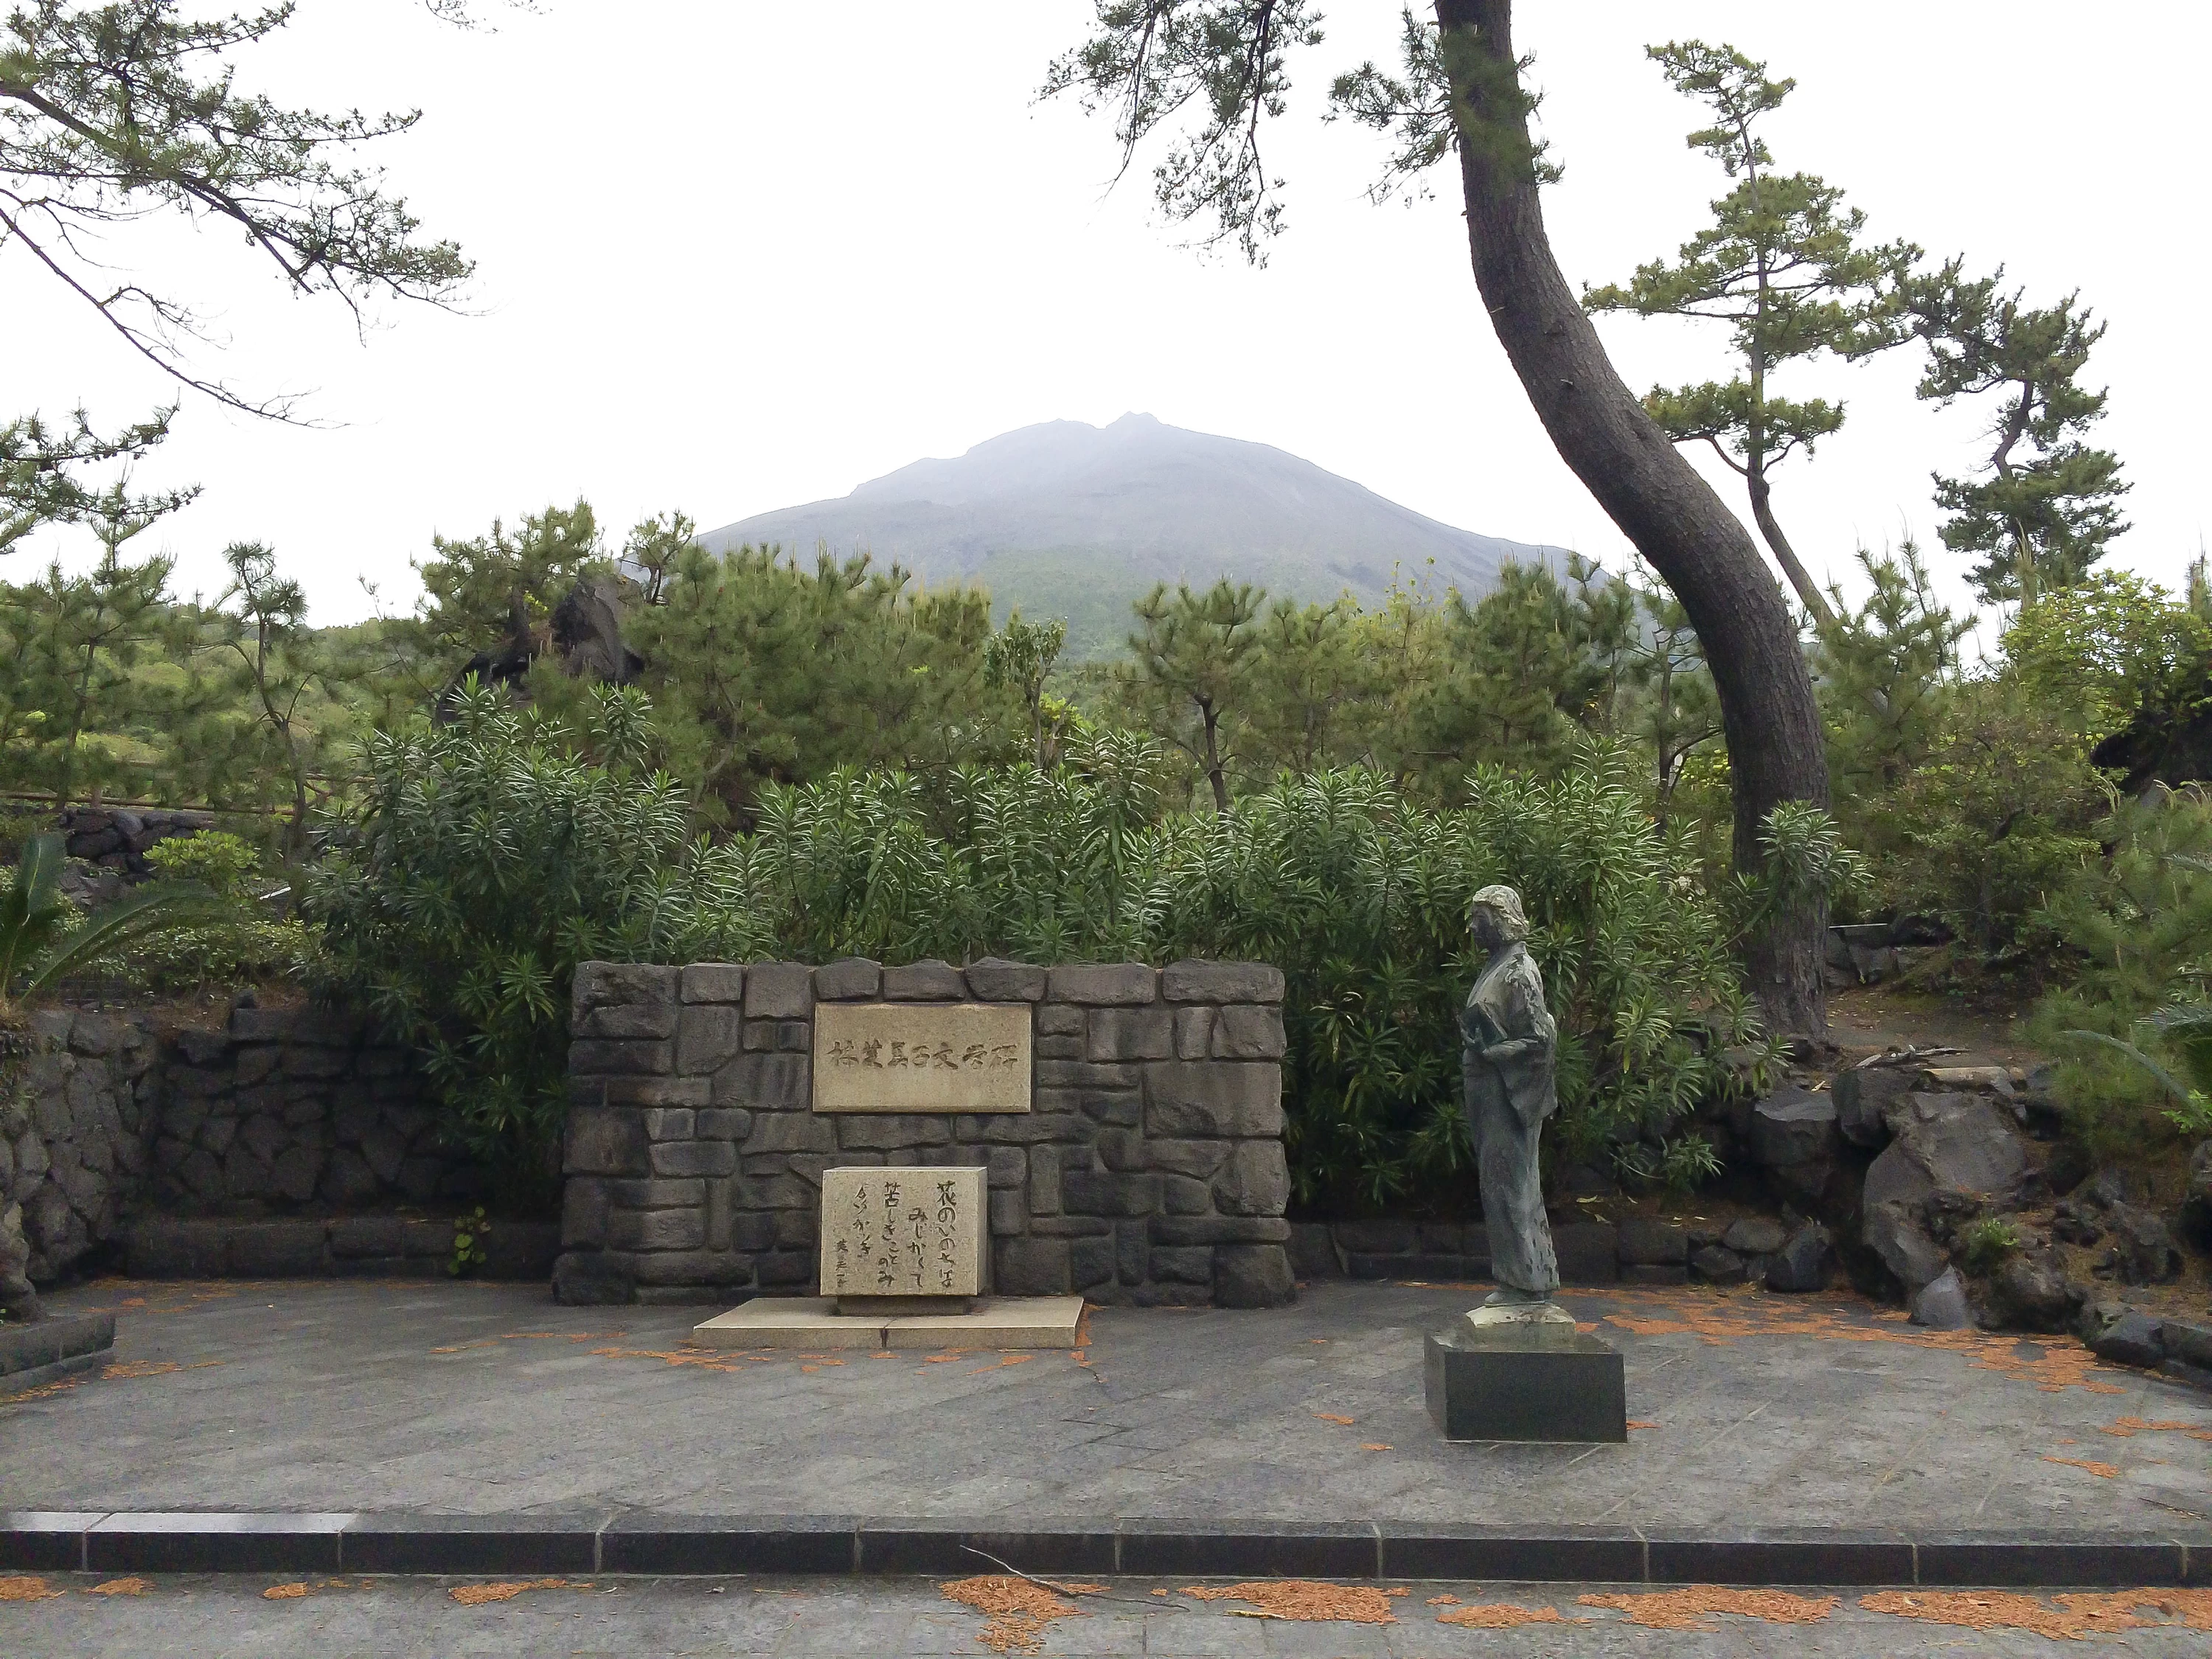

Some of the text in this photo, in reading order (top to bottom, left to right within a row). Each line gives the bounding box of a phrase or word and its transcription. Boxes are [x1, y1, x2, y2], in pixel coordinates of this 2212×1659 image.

[877, 1180, 900, 1287] 苦しきことのみ
[908, 1208, 928, 1288] みじかくて
